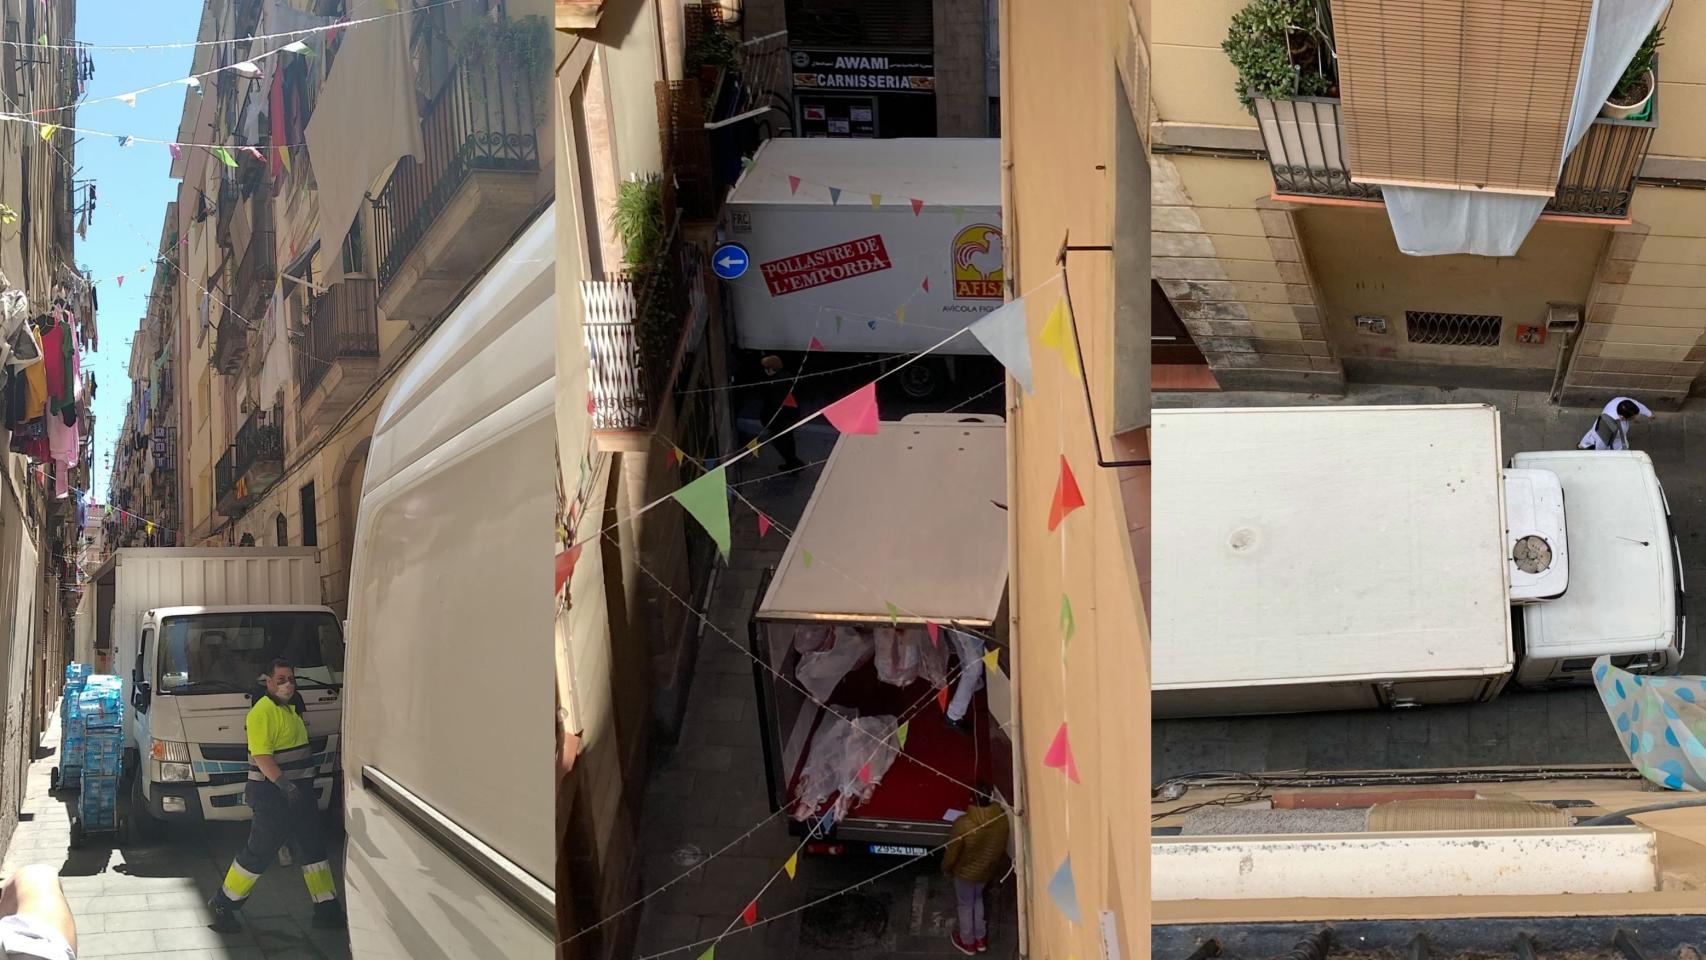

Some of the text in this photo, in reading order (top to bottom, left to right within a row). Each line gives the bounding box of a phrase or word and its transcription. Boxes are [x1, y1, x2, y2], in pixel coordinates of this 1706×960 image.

[835, 56, 889, 70] AWAMI
[817, 73, 910, 89] CARNISSERIA
[766, 237, 880, 278] POLLASTRE DE
[773, 252, 887, 295] L'EMPORDÀ
